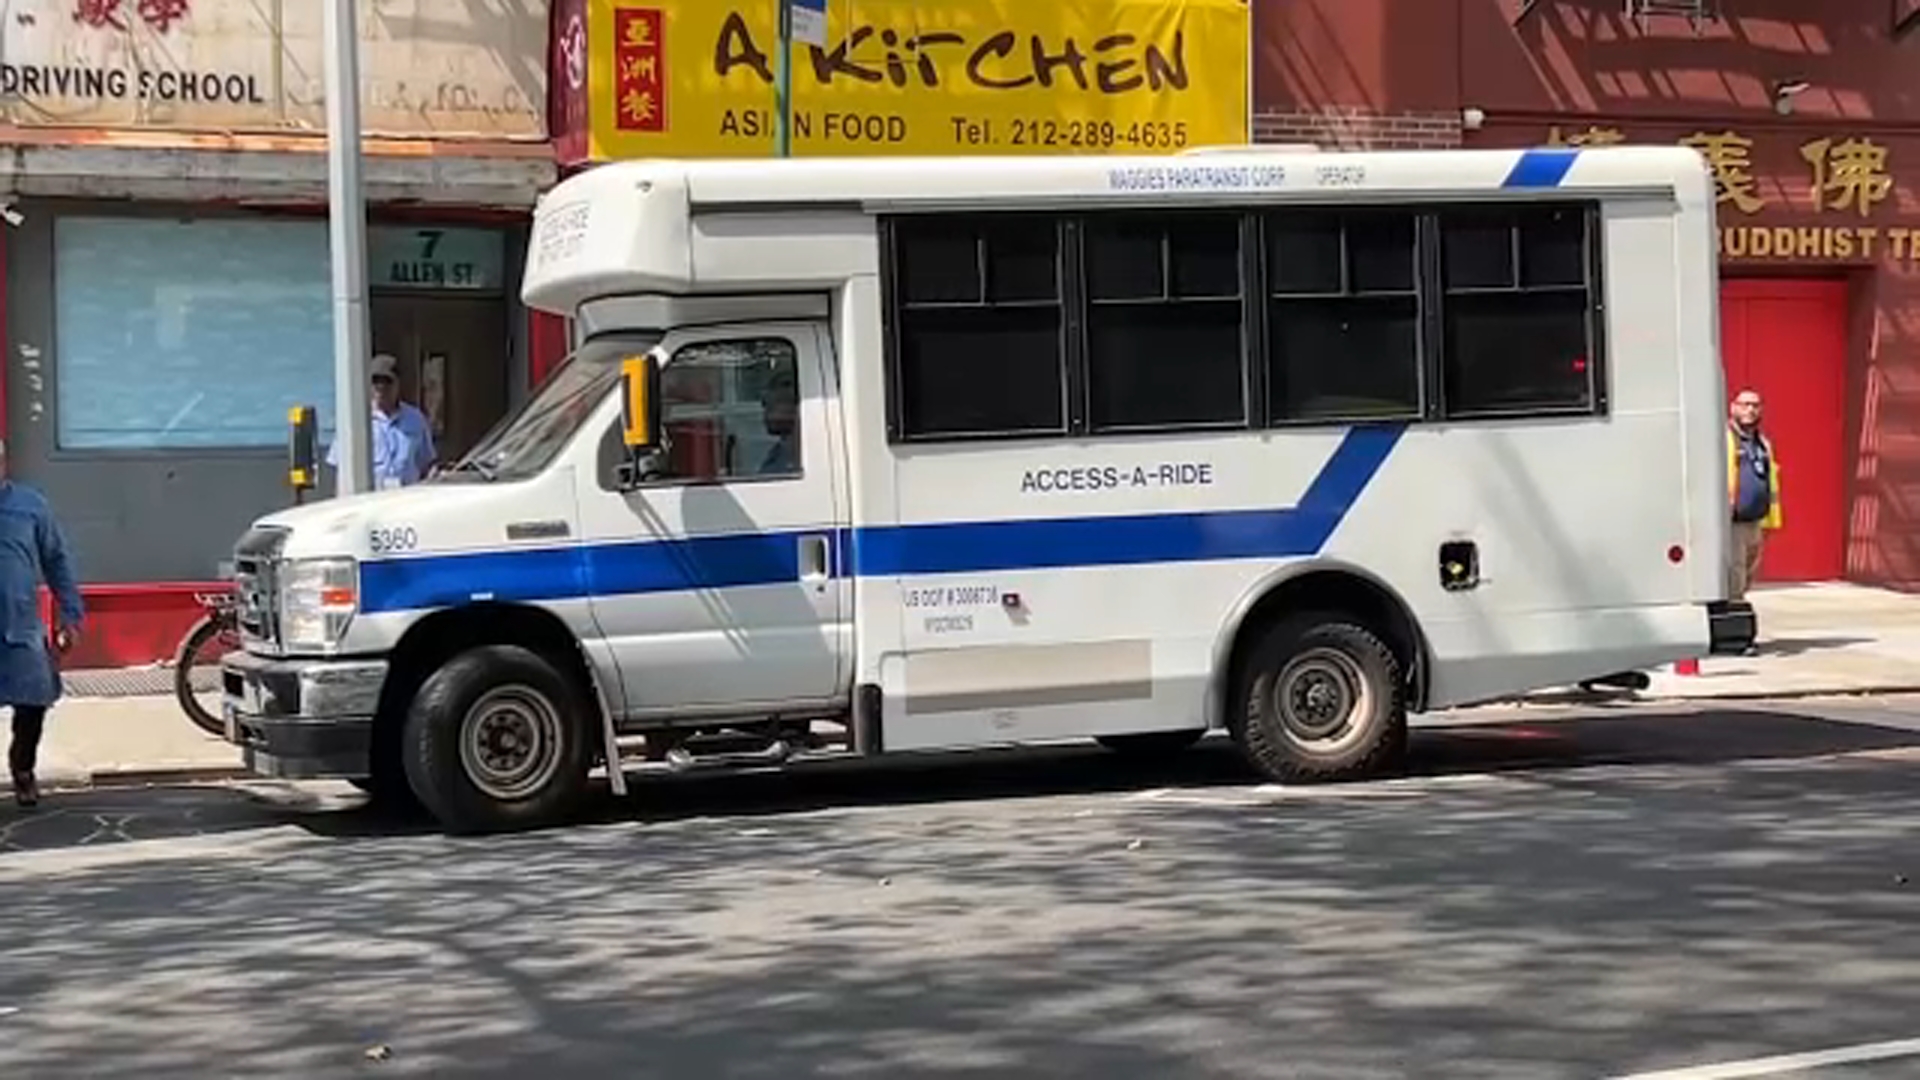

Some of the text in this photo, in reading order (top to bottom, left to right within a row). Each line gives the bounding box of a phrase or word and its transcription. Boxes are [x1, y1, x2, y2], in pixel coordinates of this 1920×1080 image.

[715, 12, 774, 84] A
[0, 62, 263, 103] DRIVING SCHOOL
[720, 109, 906, 142] ASIN FOOD
[951, 117, 1187, 147] Tel. 212-289-4635
[417, 230, 445, 259] 7
[1717, 227, 1877, 258] UDDHIST
[390, 261, 474, 286] ALLEN ST
[1021, 463, 1213, 492] ACCESS-A-RIDE
